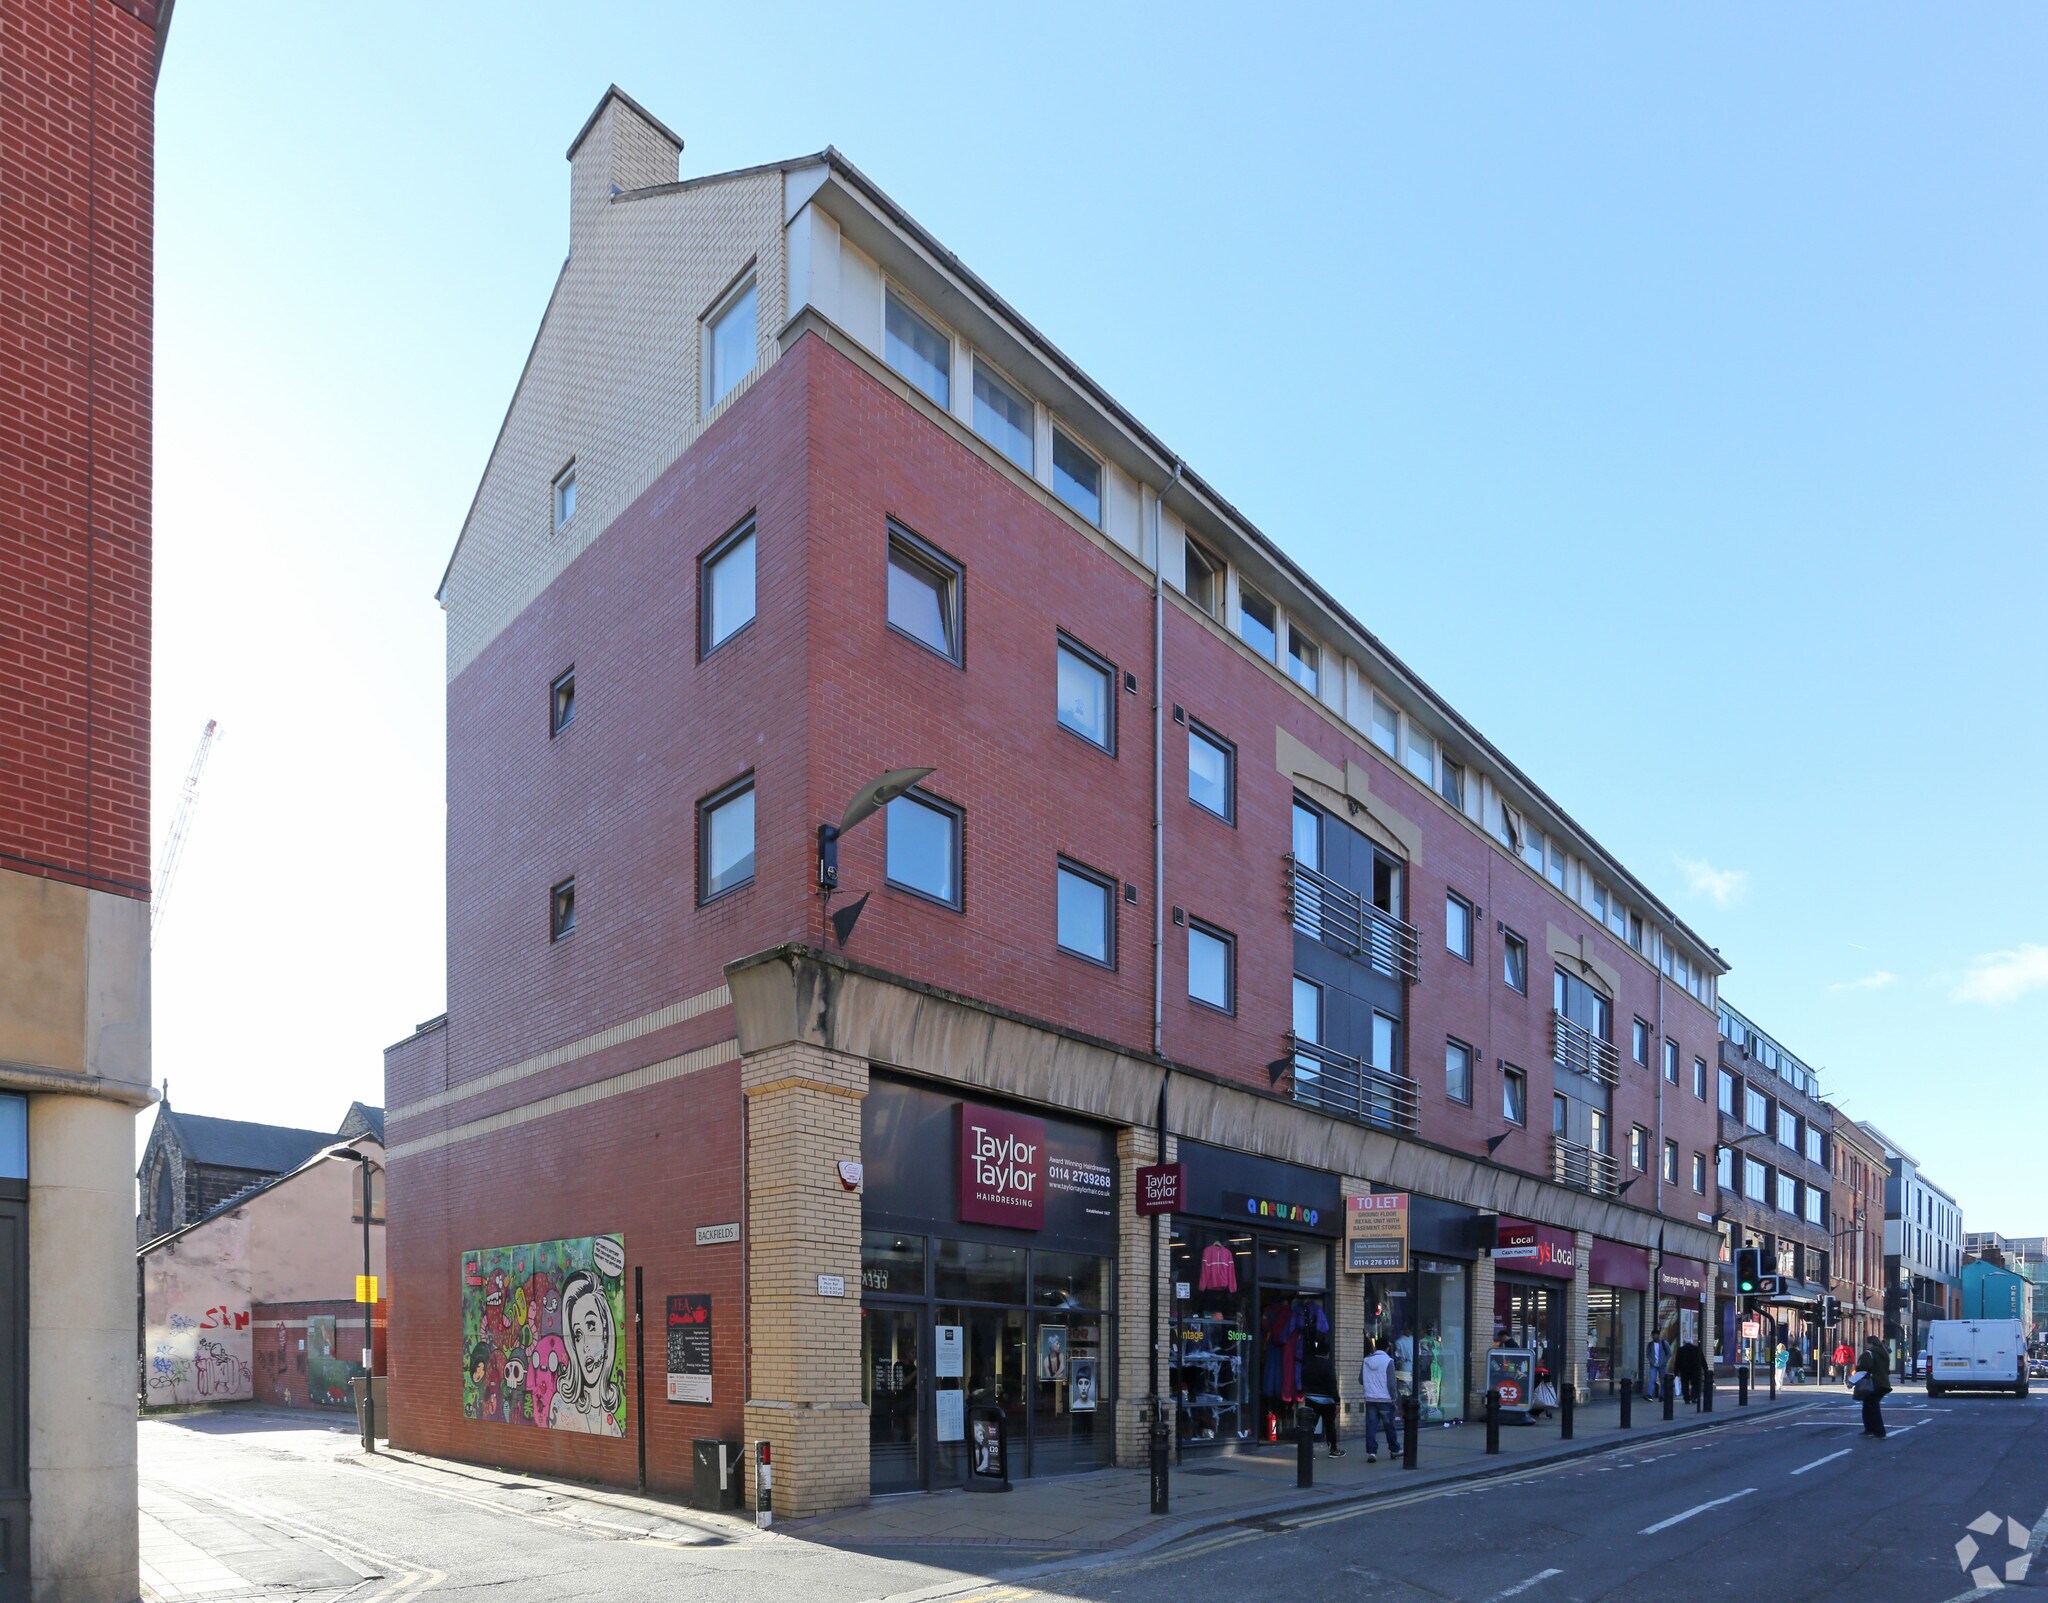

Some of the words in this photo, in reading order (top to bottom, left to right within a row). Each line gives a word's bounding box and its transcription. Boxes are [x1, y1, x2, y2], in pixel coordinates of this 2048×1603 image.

[971, 1126, 1037, 1165] Taylor
[1049, 1156, 1064, 1165] Award
[1064, 1159, 1082, 1170] Winning
[1083, 1162, 1110, 1173] Hairdressers
[971, 1154, 1036, 1193] Taylor
[1049, 1166, 1069, 1180] 0114
[1072, 1170, 1111, 1187] 2739268
[1145, 1173, 1177, 1188] Taylor
[976, 1192, 1033, 1207] HAIRDRESSING
[1145, 1185, 1177, 1200] Taylor
[1357, 1197, 1373, 1209] TO
[1376, 1196, 1399, 1209] LET
[1247, 1198, 1257, 1214] a
[1260, 1200, 1287, 1219] new
[1290, 1204, 1318, 1227] shop
[698, 1227, 734, 1241] BACKFIELDS
[1510, 1235, 1534, 1245] Local
[1551, 1242, 1575, 1266] Local
[672, 1298, 691, 1313] TEA
[1174, 1329, 1203, 1342] ntage
[1228, 1330, 1247, 1340] Store
[1499, 1386, 1517, 1399] £3
